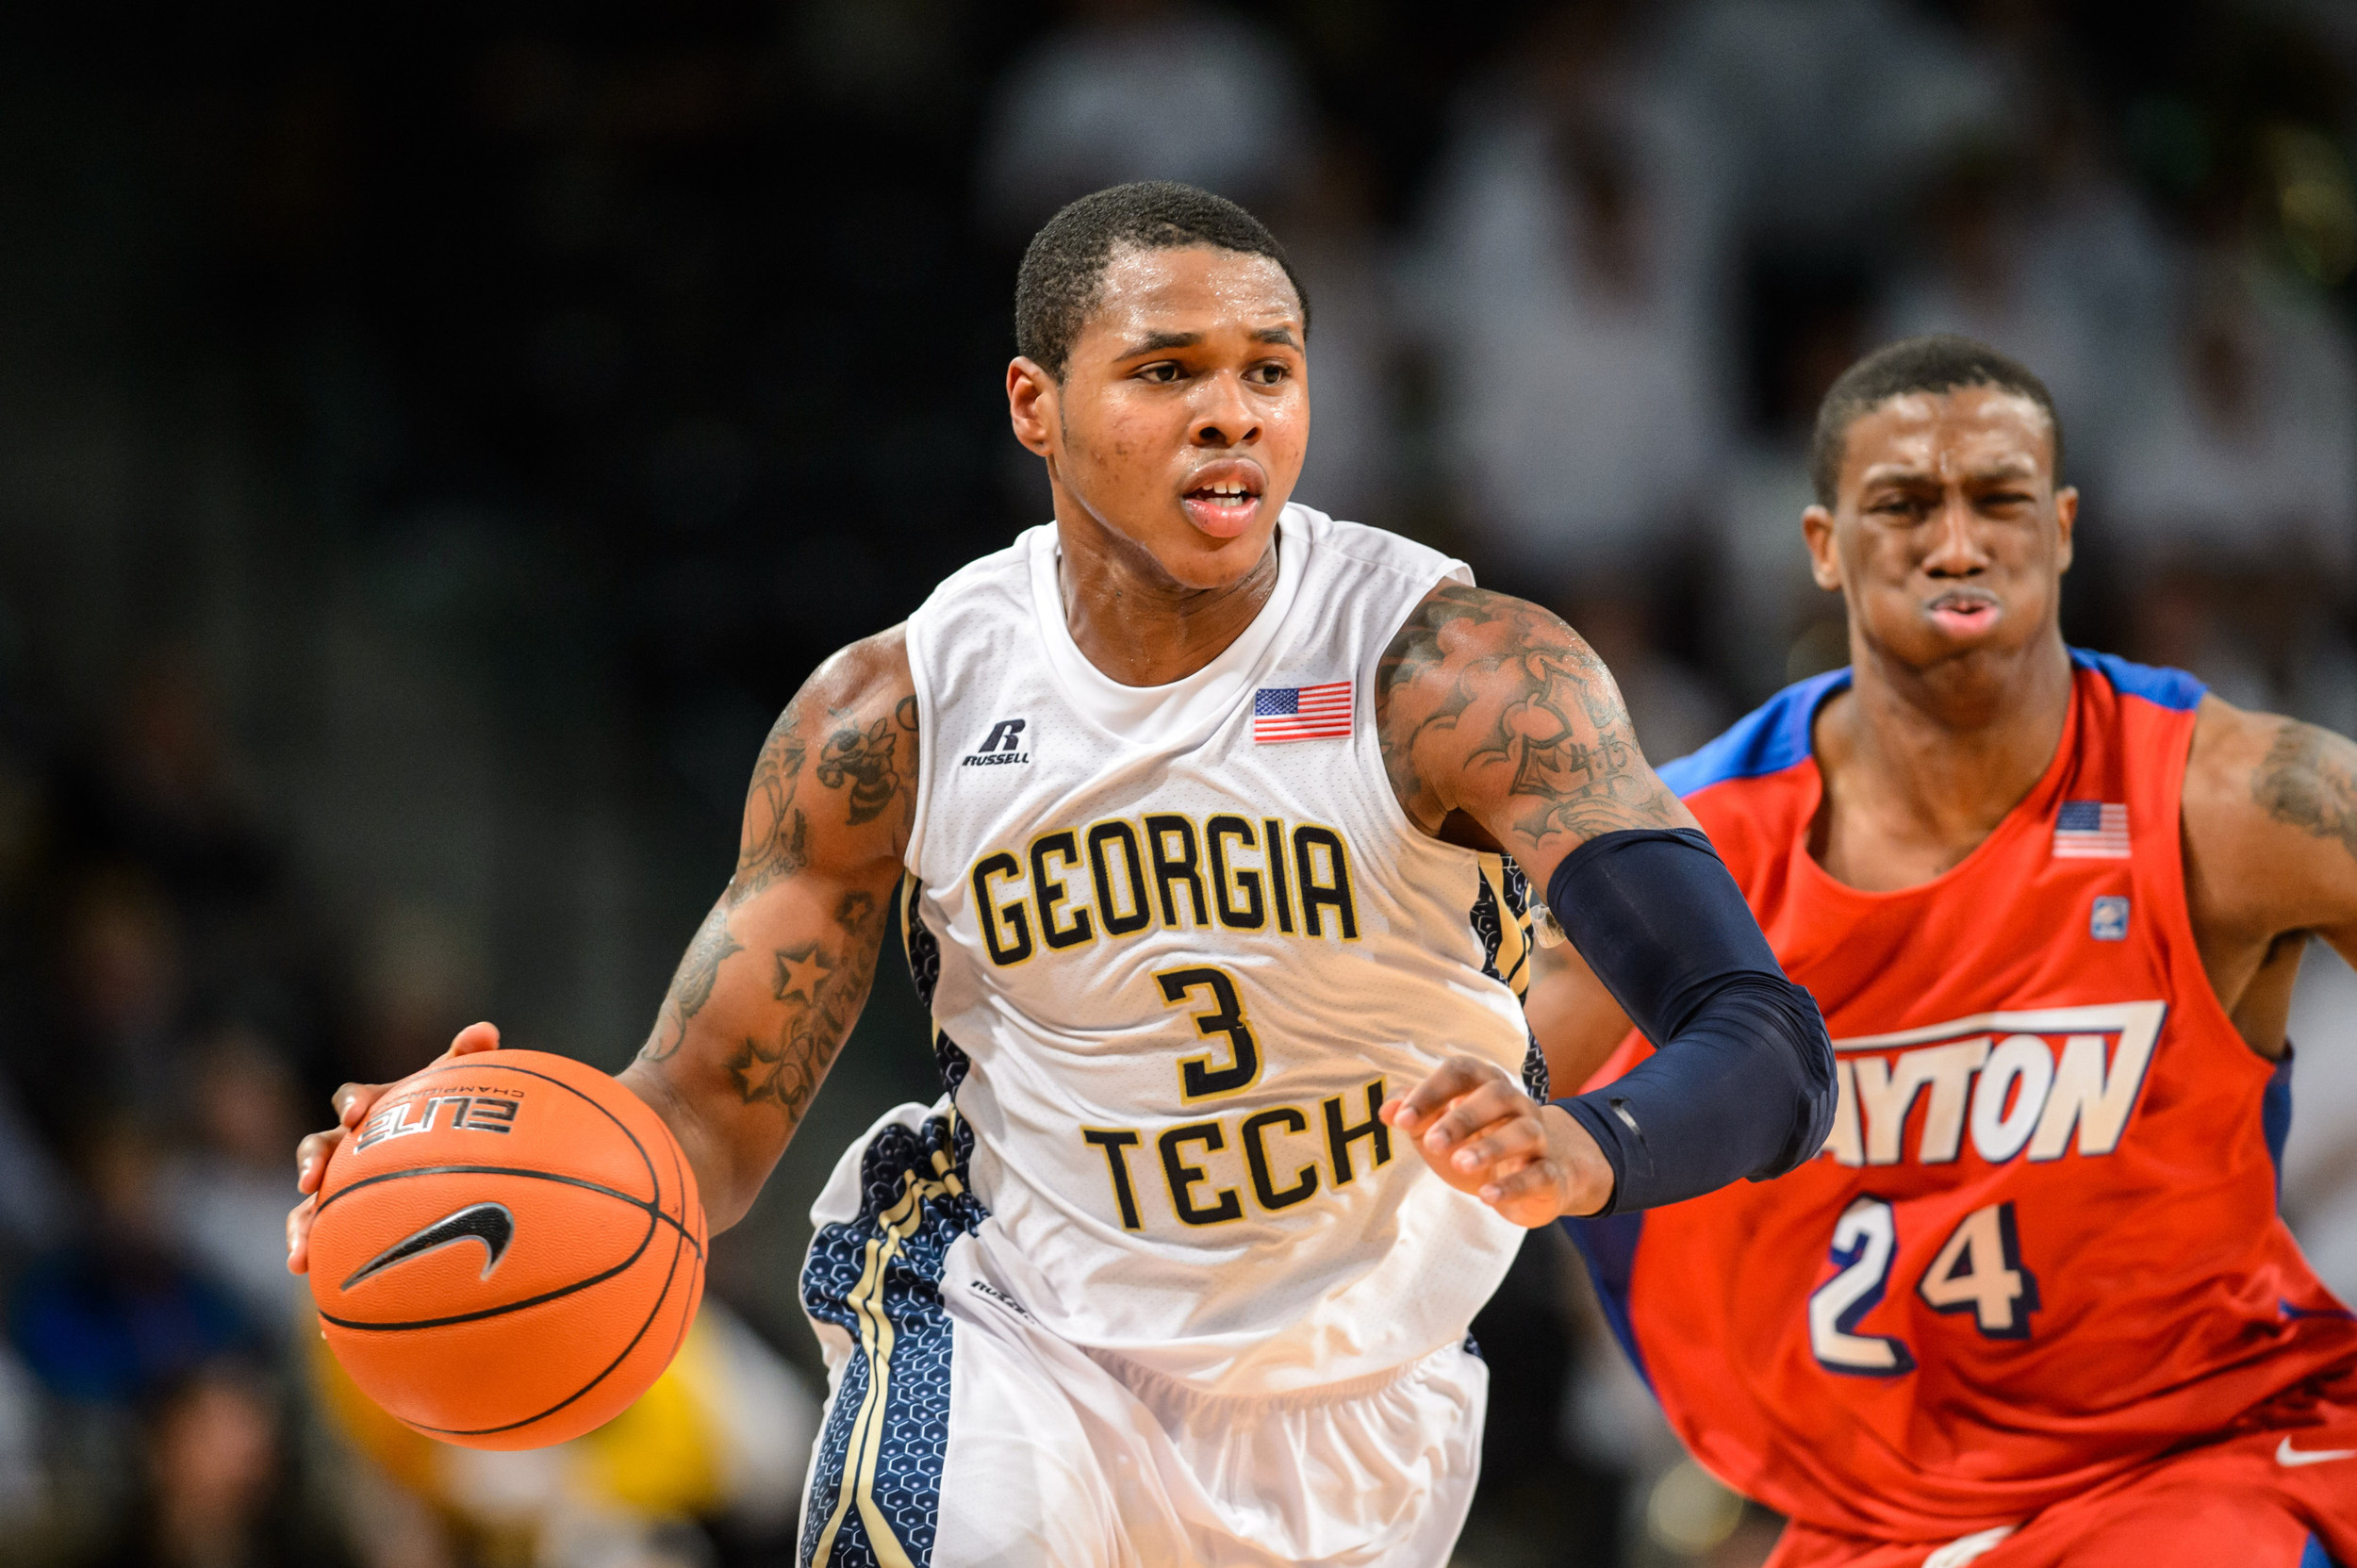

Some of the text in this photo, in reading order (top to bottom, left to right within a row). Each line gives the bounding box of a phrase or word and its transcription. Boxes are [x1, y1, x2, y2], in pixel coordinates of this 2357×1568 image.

[962, 752, 1030, 767] RUSSELL
[970, 812, 1361, 967] GEORGIA
[1152, 966, 1263, 1104] 3
[1817, 1000, 2167, 1168] AYTON
[353, 1096, 520, 1155] ELITE
[1080, 1076, 1394, 1232] TECH
[1808, 1192, 2040, 1378] 24
